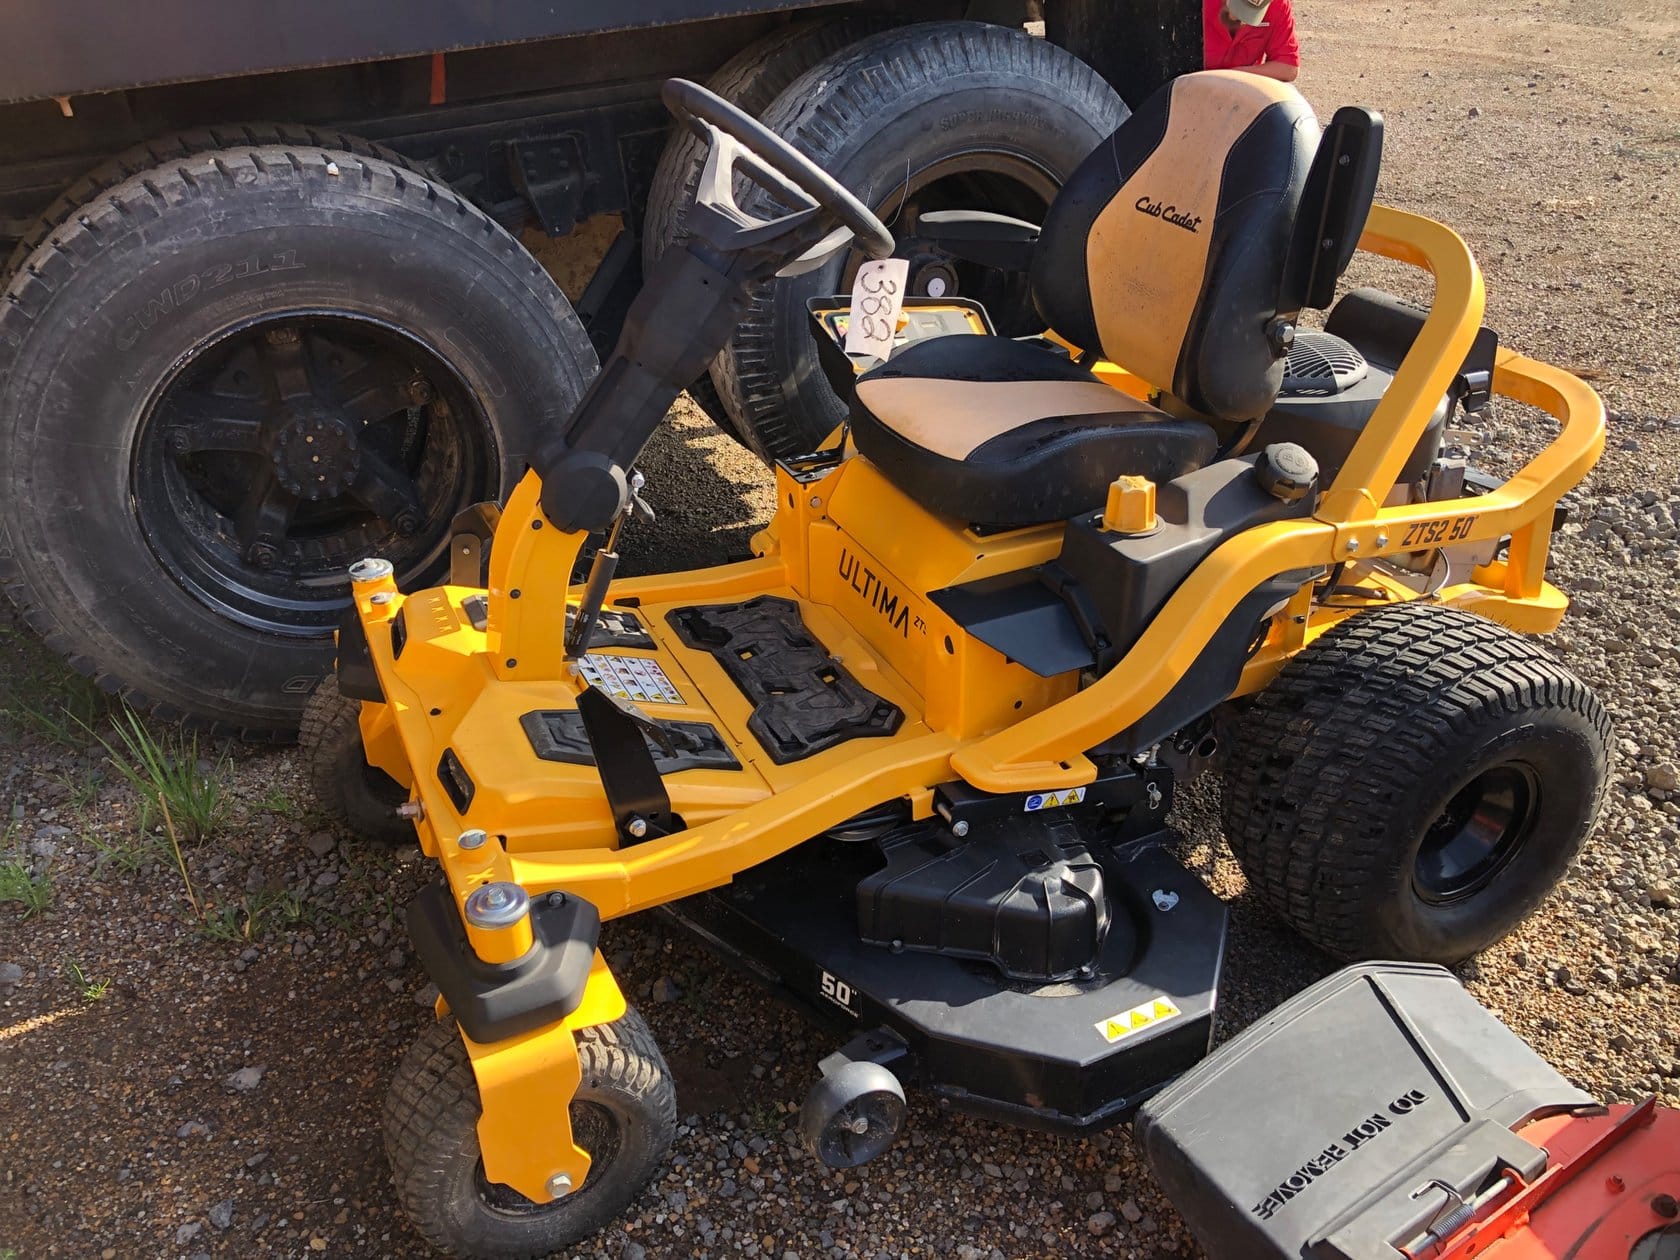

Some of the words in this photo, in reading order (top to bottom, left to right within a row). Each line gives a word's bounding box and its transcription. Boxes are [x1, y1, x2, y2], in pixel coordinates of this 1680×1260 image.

[1135, 196, 1163, 218] Cub
[1161, 205, 1202, 234] Cadet
[860, 272, 897, 342] 382
[1401, 520, 1449, 546] ZTS2
[839, 547, 909, 639] ULTIMA
[1388, 1089, 1430, 1115] DO
[1342, 1113, 1394, 1151] NOT
[1251, 1143, 1351, 1221] REMOVE
